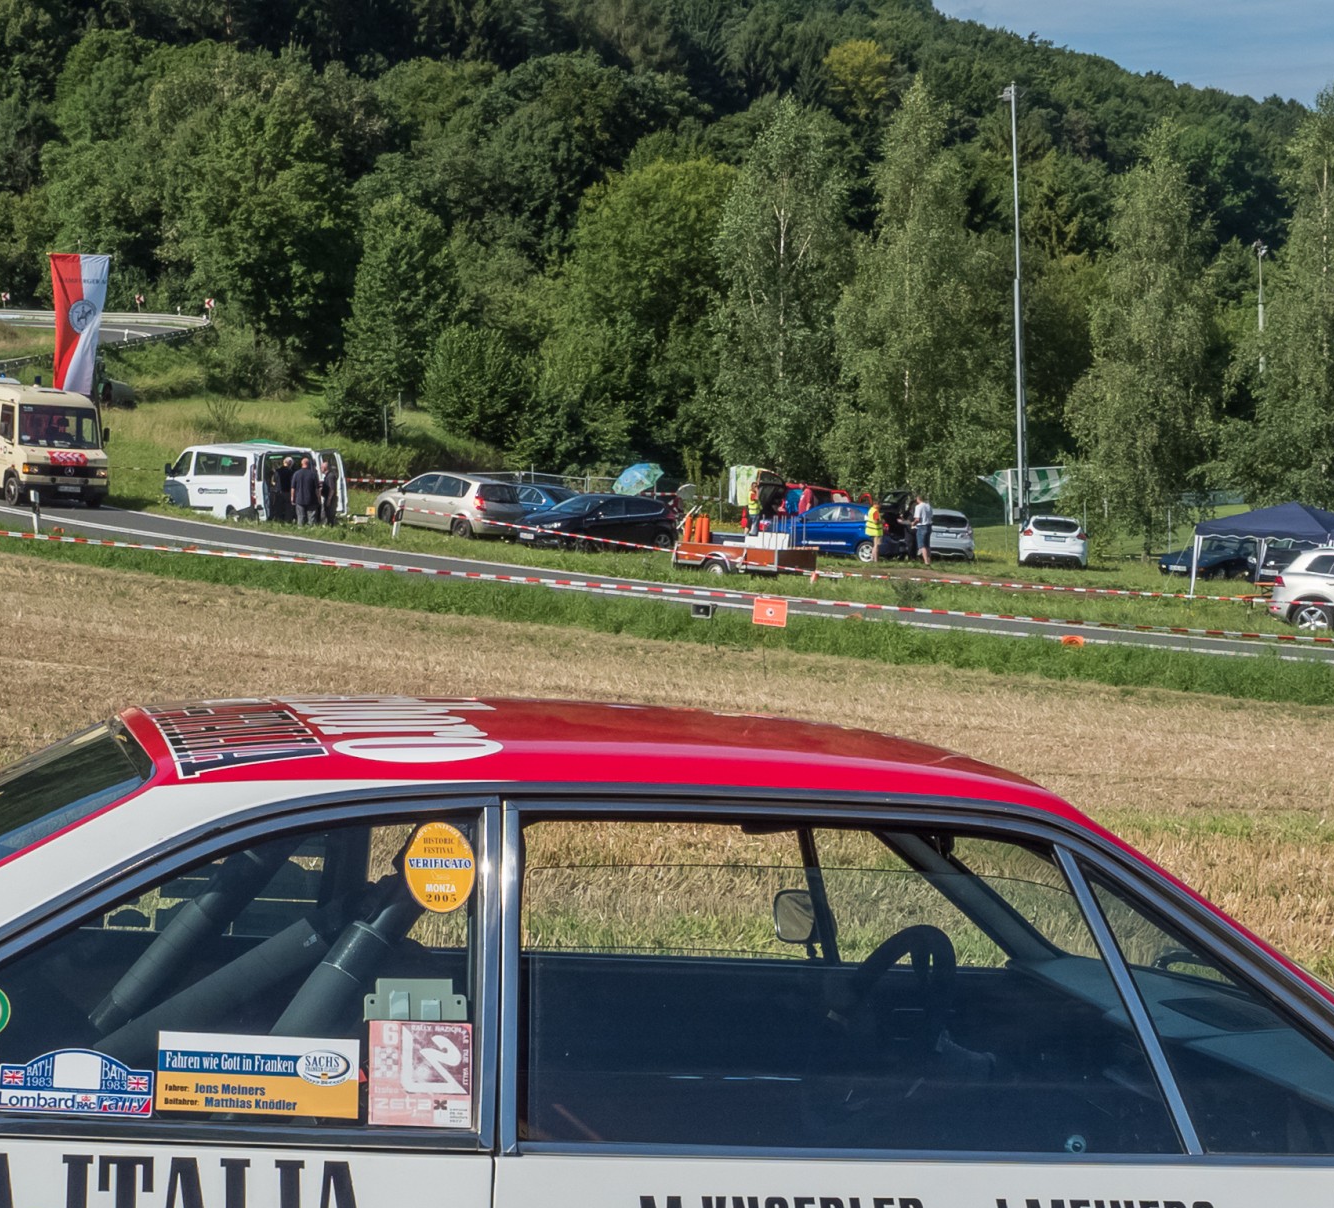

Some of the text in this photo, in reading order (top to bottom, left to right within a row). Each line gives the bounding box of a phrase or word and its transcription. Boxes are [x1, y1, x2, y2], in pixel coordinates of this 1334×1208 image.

[423, 837, 455, 845] HISTORIC
[409, 859, 471, 869] VERIFICATO
[425, 883, 456, 892] MONZA
[426, 895, 457, 903] 2005
[165, 1052, 294, 1073] Fahren wie Gott in Franken
[305, 1055, 340, 1068] SACHS
[27, 1057, 127, 1080] BATH BATH
[26, 1077, 53, 1087] 1983
[102, 1080, 127, 1091] 1983
[165, 1083, 266, 1096] Fahrer: Jens Meiners
[77, 1101, 96, 1110] RAC
[97, 1096, 146, 1112] rally
[204, 1097, 252, 1109] Matthias
[255, 1098, 298, 1111] Knödler
